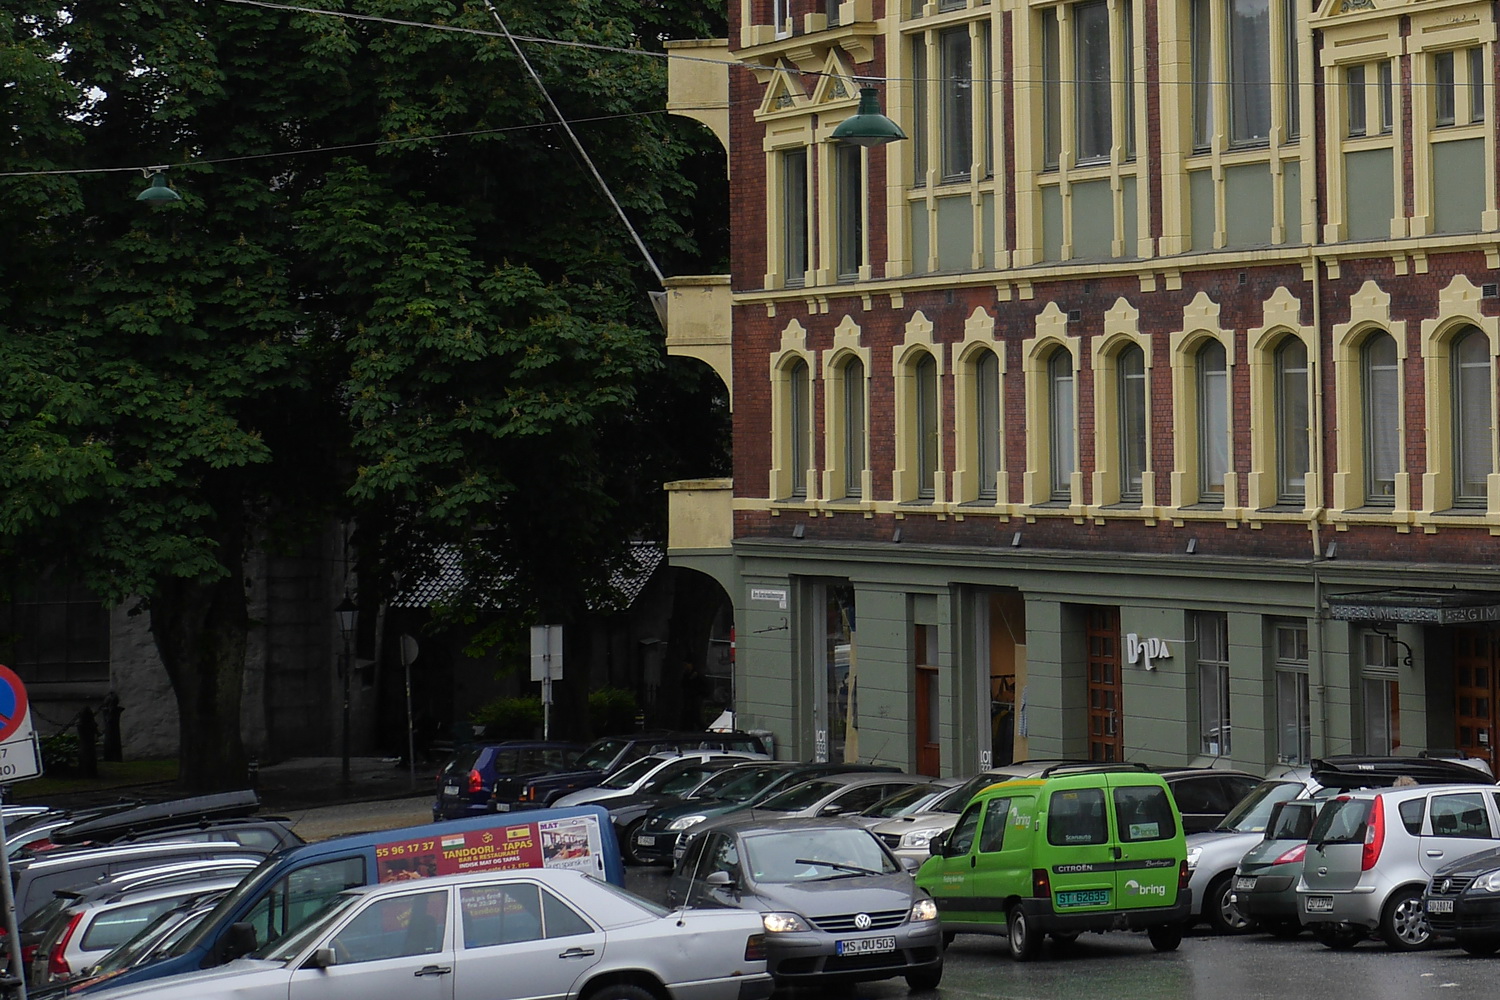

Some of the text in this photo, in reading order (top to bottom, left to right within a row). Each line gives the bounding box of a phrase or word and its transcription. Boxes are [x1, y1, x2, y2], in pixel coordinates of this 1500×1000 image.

[816, 730, 826, 741] LOT
[980, 750, 991, 763] LOT
[540, 822, 558, 830] MAT
[376, 841, 434, 858] 55 96 17 37
[442, 845, 494, 859] TANDOORI
[502, 840, 533, 851] TAPAS
[458, 855, 472, 863] BAR
[479, 850, 519, 860] RESTAURANT
[1058, 864, 1093, 872] CITROËN
[1139, 884, 1166, 896] bring
[1059, 891, 1106, 903] ST 62635
[842, 938, 894, 952] MS QU 503
